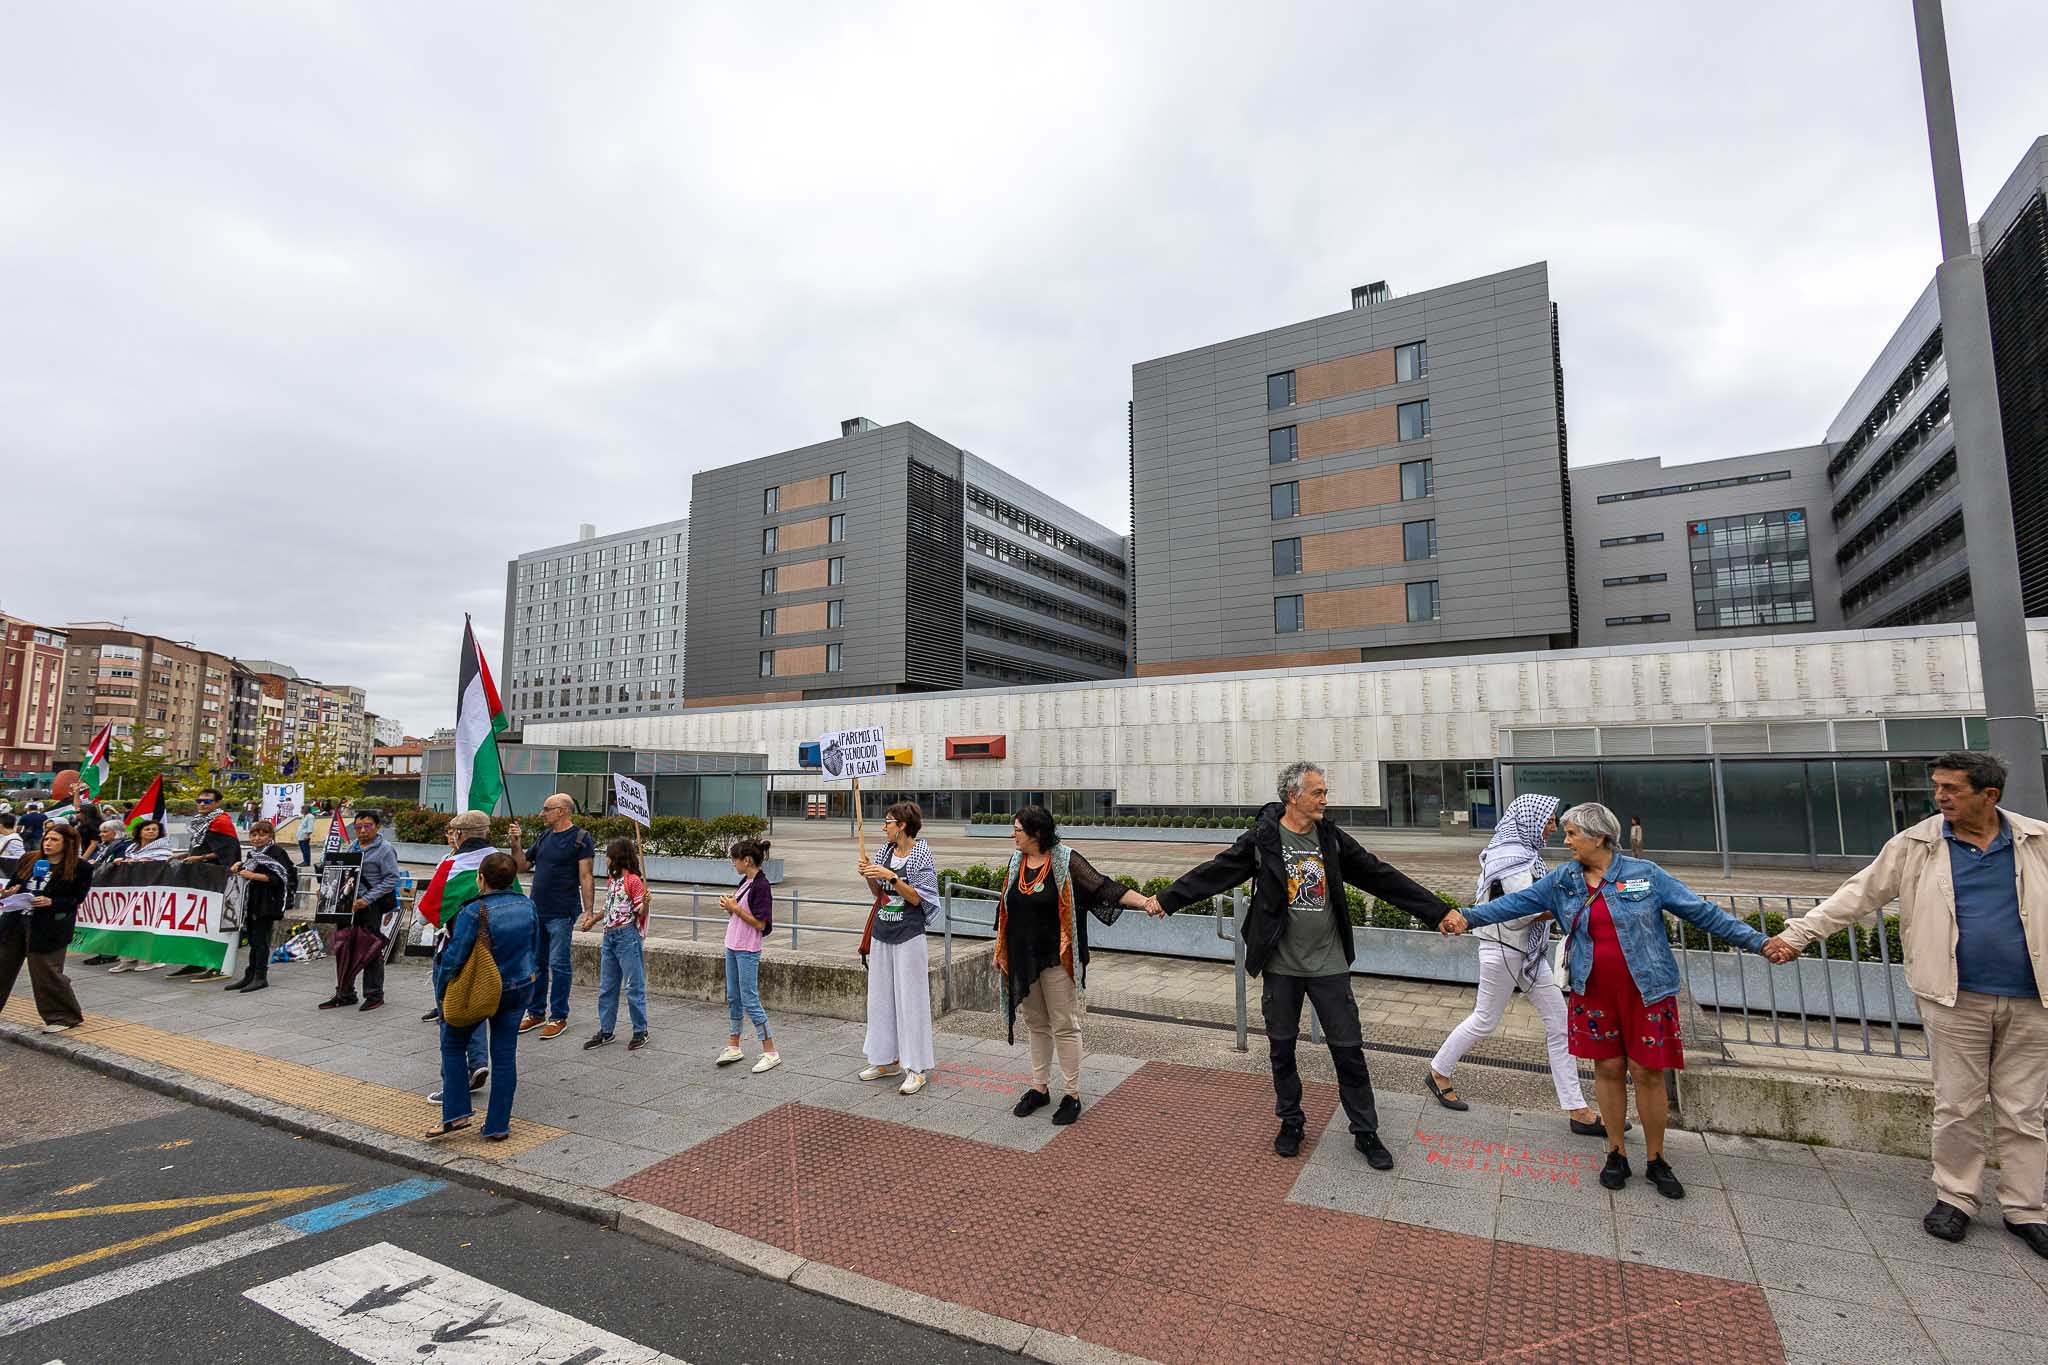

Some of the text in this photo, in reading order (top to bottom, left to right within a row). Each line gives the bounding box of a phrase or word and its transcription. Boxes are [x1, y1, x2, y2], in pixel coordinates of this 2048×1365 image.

[838, 729, 881, 746] ¡PAREMOS EL
[844, 744, 878, 761] GENOCIDIO
[845, 759, 879, 776] EN GAZA!
[156, 889, 209, 934] AZA
